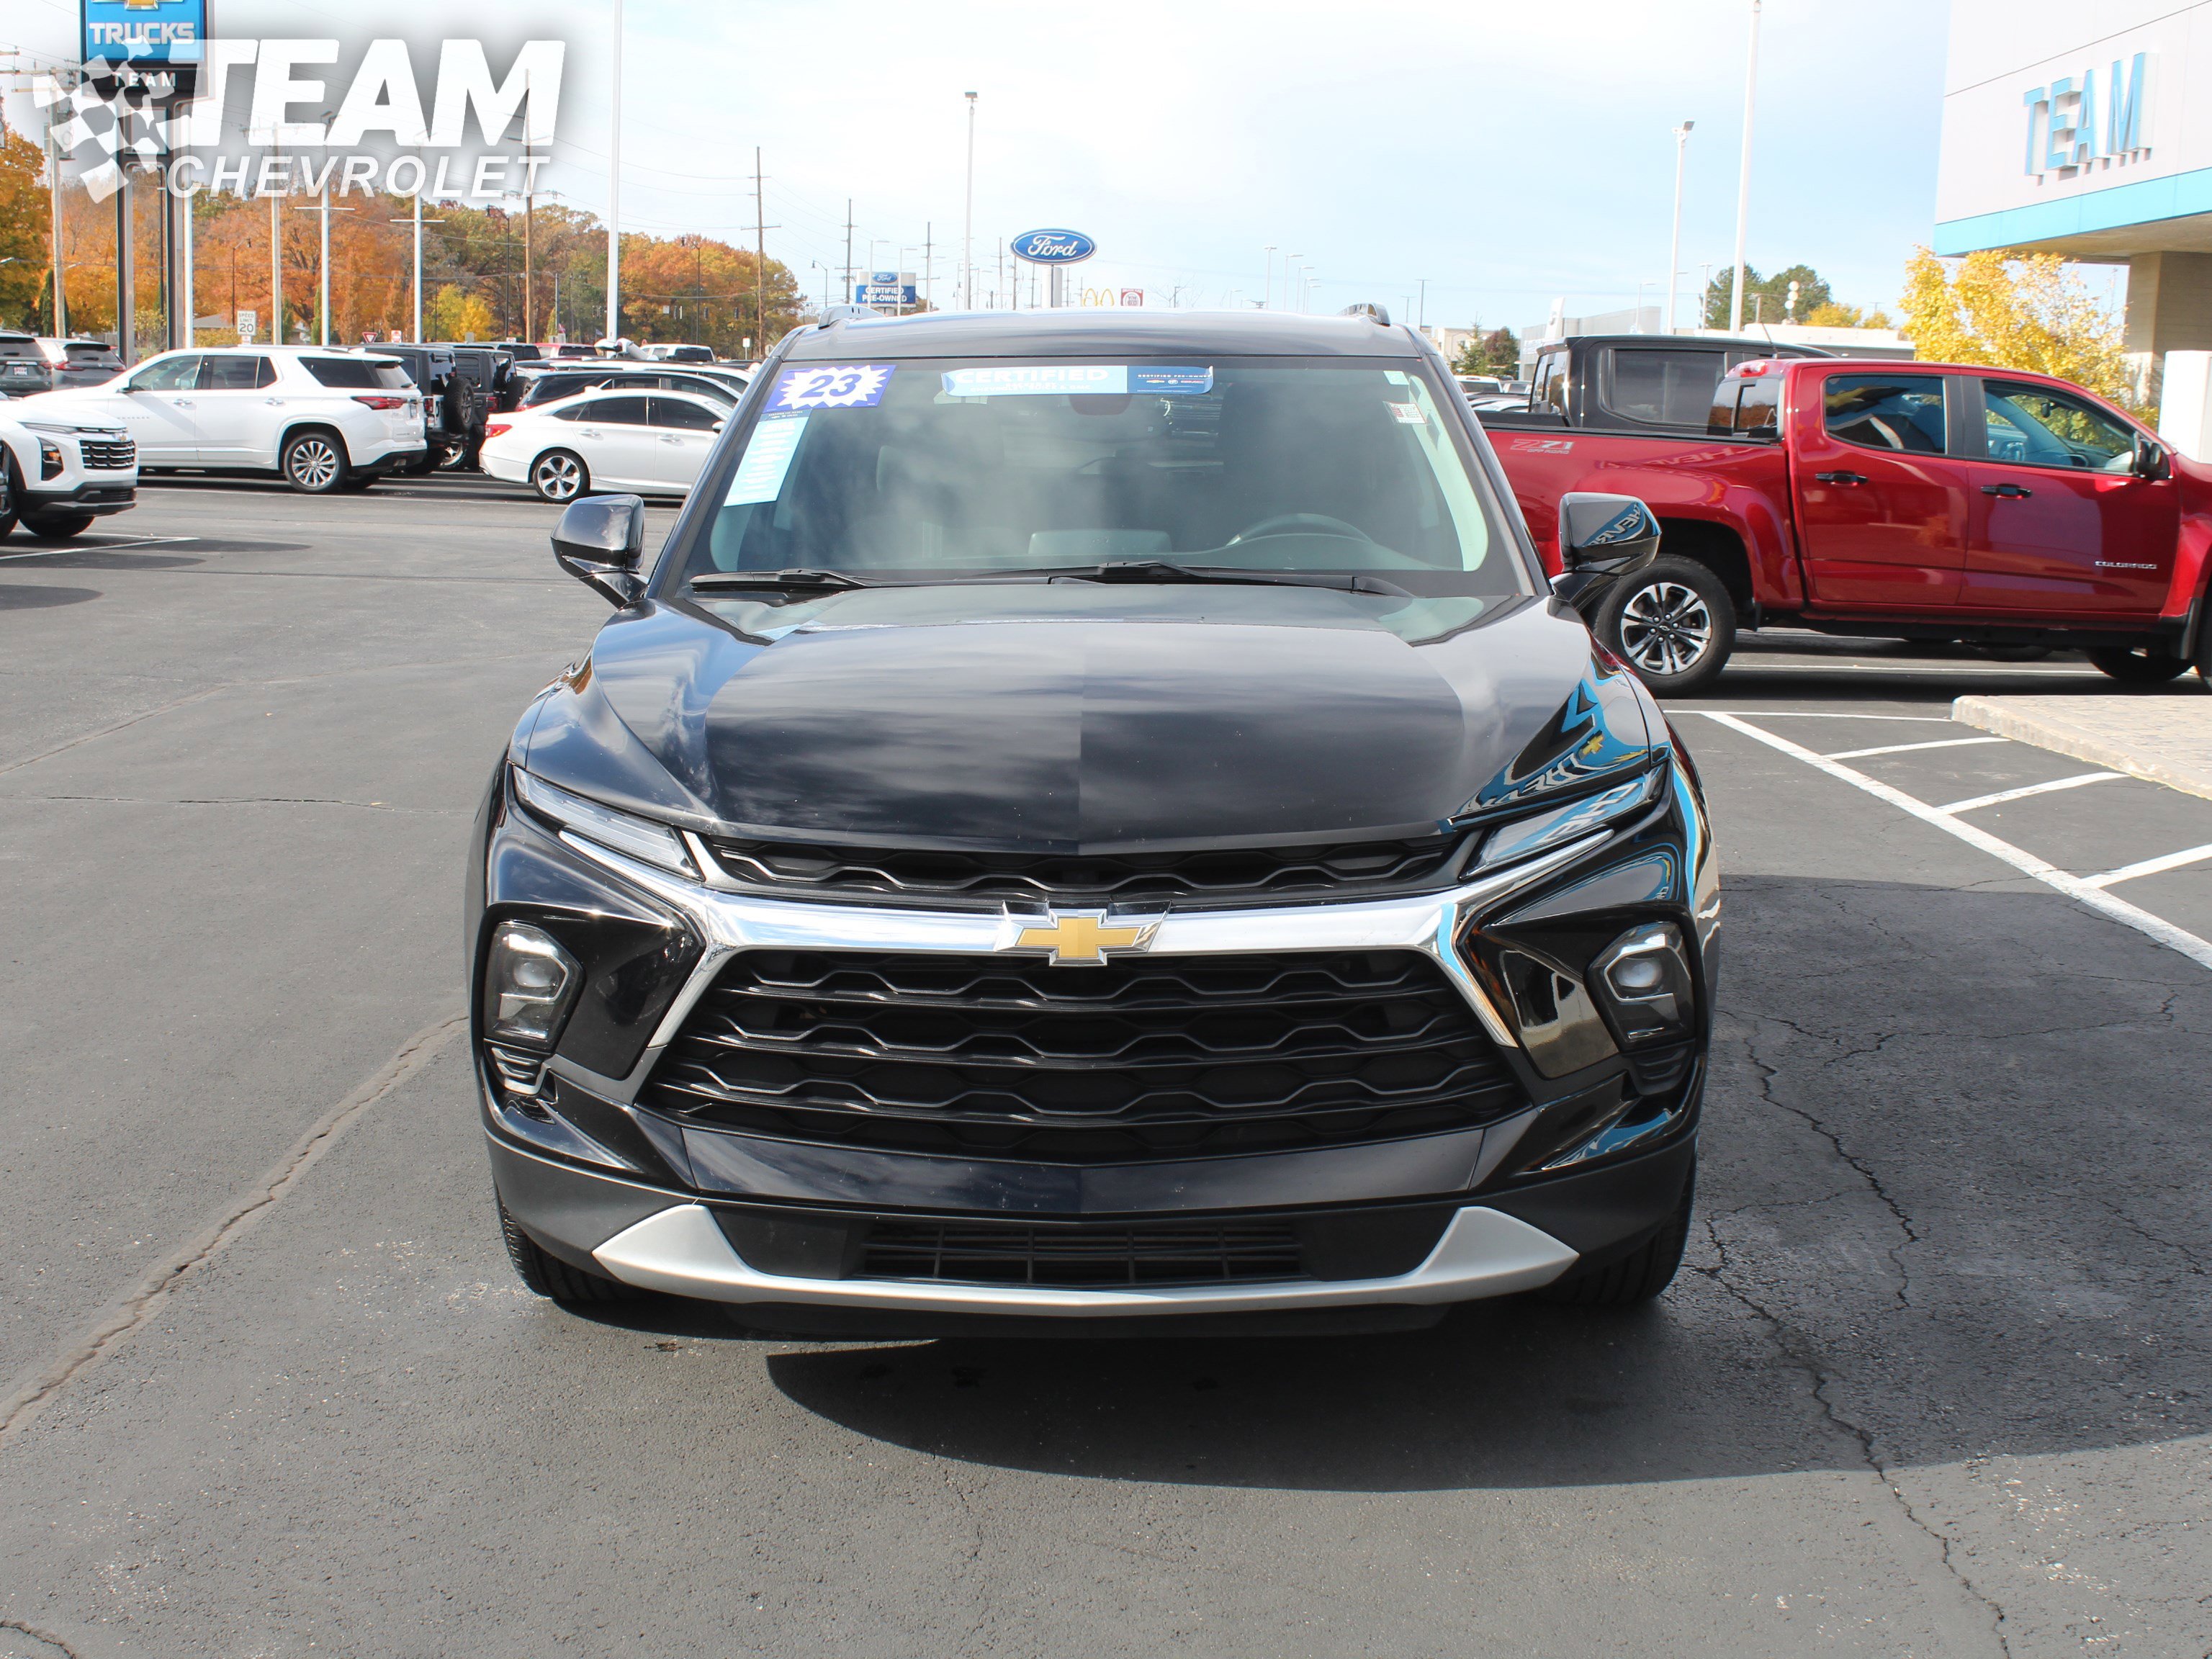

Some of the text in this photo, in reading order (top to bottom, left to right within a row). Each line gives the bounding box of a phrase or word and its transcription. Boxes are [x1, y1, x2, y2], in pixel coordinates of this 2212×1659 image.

[89, 22, 194, 45] TRUCKS
[112, 71, 176, 87] TEAM
[2023, 52, 2155, 176] TEAM
[1028, 235, 1079, 256] Ford
[239, 323, 253, 332] 20
[956, 369, 1109, 384] CERTIFIED
[799, 374, 863, 398] 23
[1510, 439, 1575, 451] Z71
